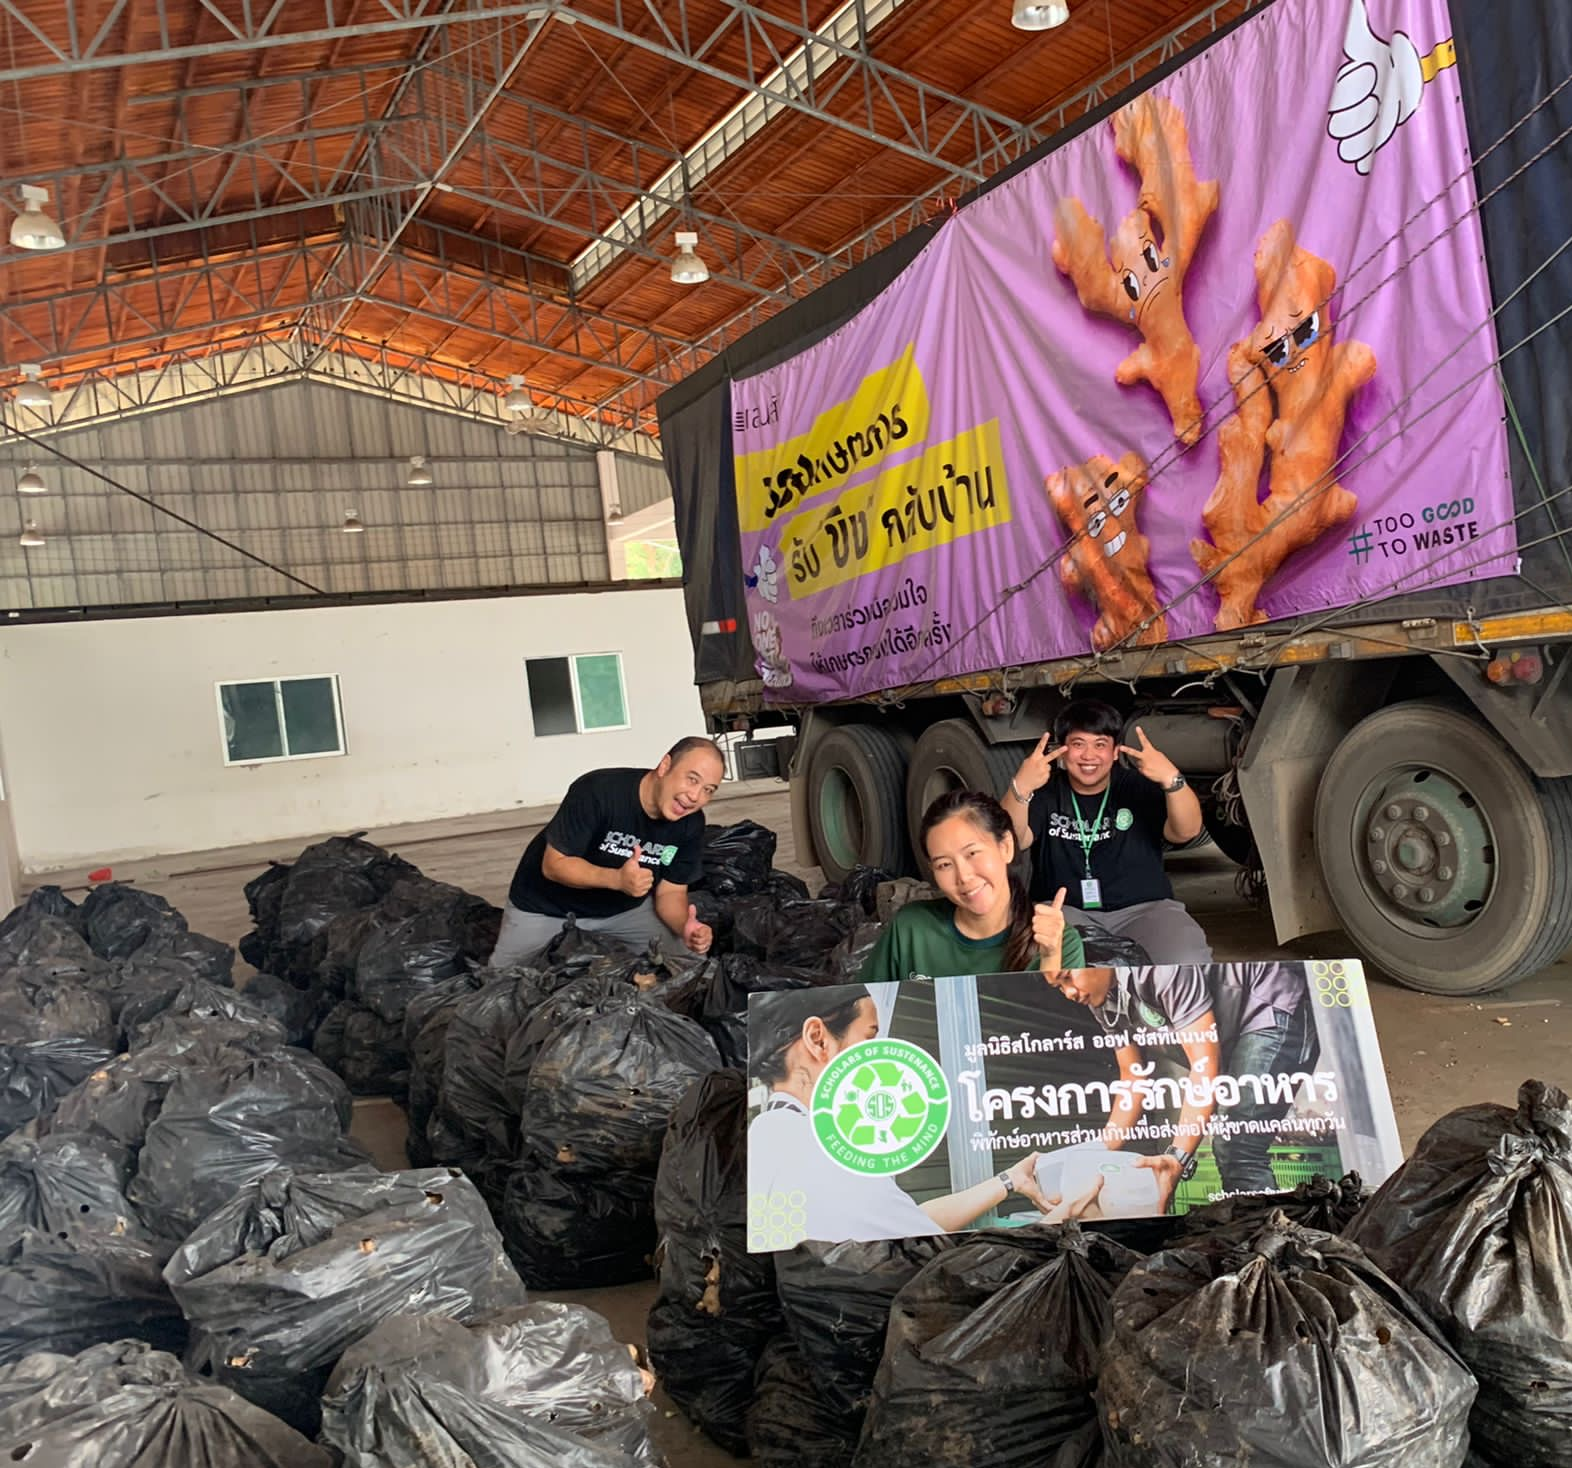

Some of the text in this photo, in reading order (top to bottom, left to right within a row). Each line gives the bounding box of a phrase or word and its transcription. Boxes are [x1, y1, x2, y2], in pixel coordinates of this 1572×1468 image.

[1421, 497, 1475, 524] GOOD
[1377, 520, 1480, 558] TO WASTE
[1092, 1028, 1129, 1048] ออฟ
[820, 1045, 940, 1100] SCHOLARS OF SUSTENANCE
[958, 1055, 1339, 1122] โครงการรักษ์อาหาร
[825, 1123, 939, 1169] FEEDING THE MIND
